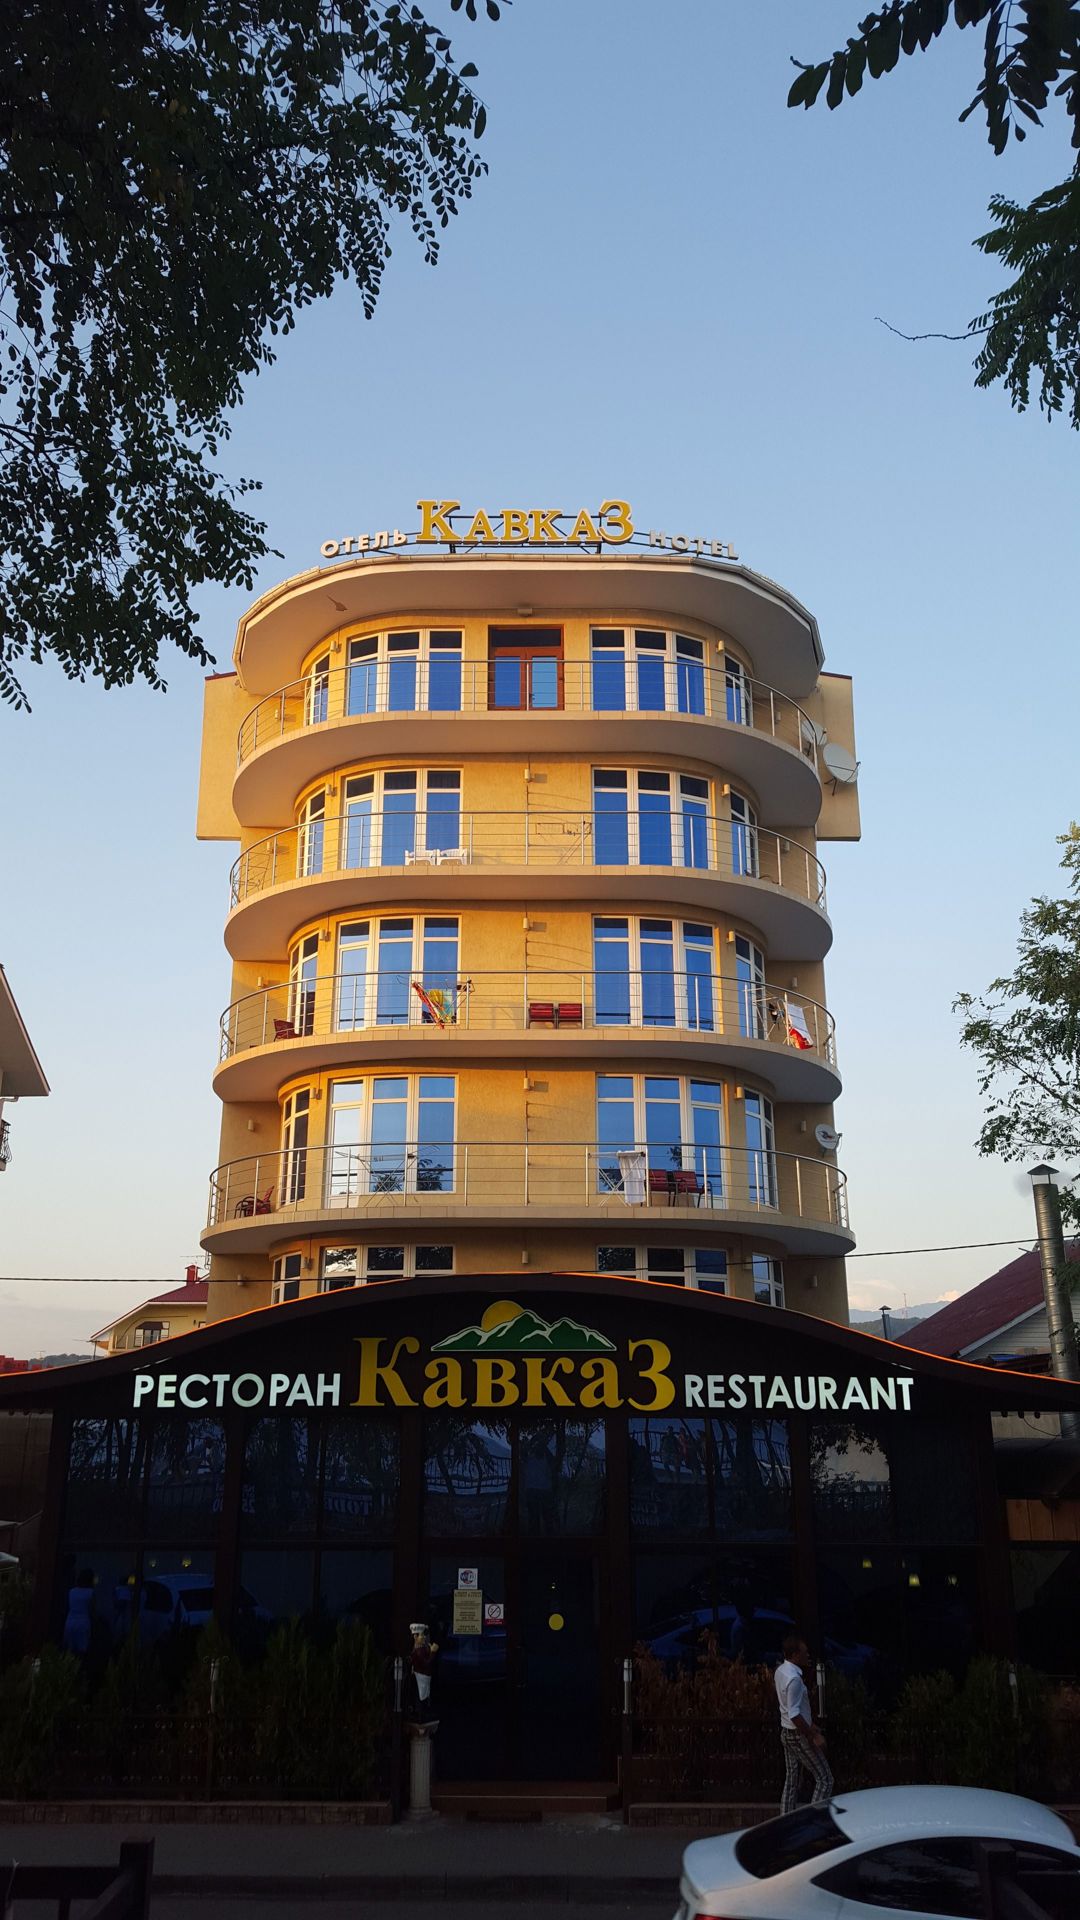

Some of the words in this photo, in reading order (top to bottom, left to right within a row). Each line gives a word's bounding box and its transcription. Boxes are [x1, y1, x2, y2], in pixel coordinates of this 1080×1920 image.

[321, 529, 408, 558] ОТЕЛЬ
[649, 529, 740, 560] HOTEL
[133, 1372, 341, 1409] РЕСТОРАН
[684, 1373, 914, 1411] RESTAURANT
